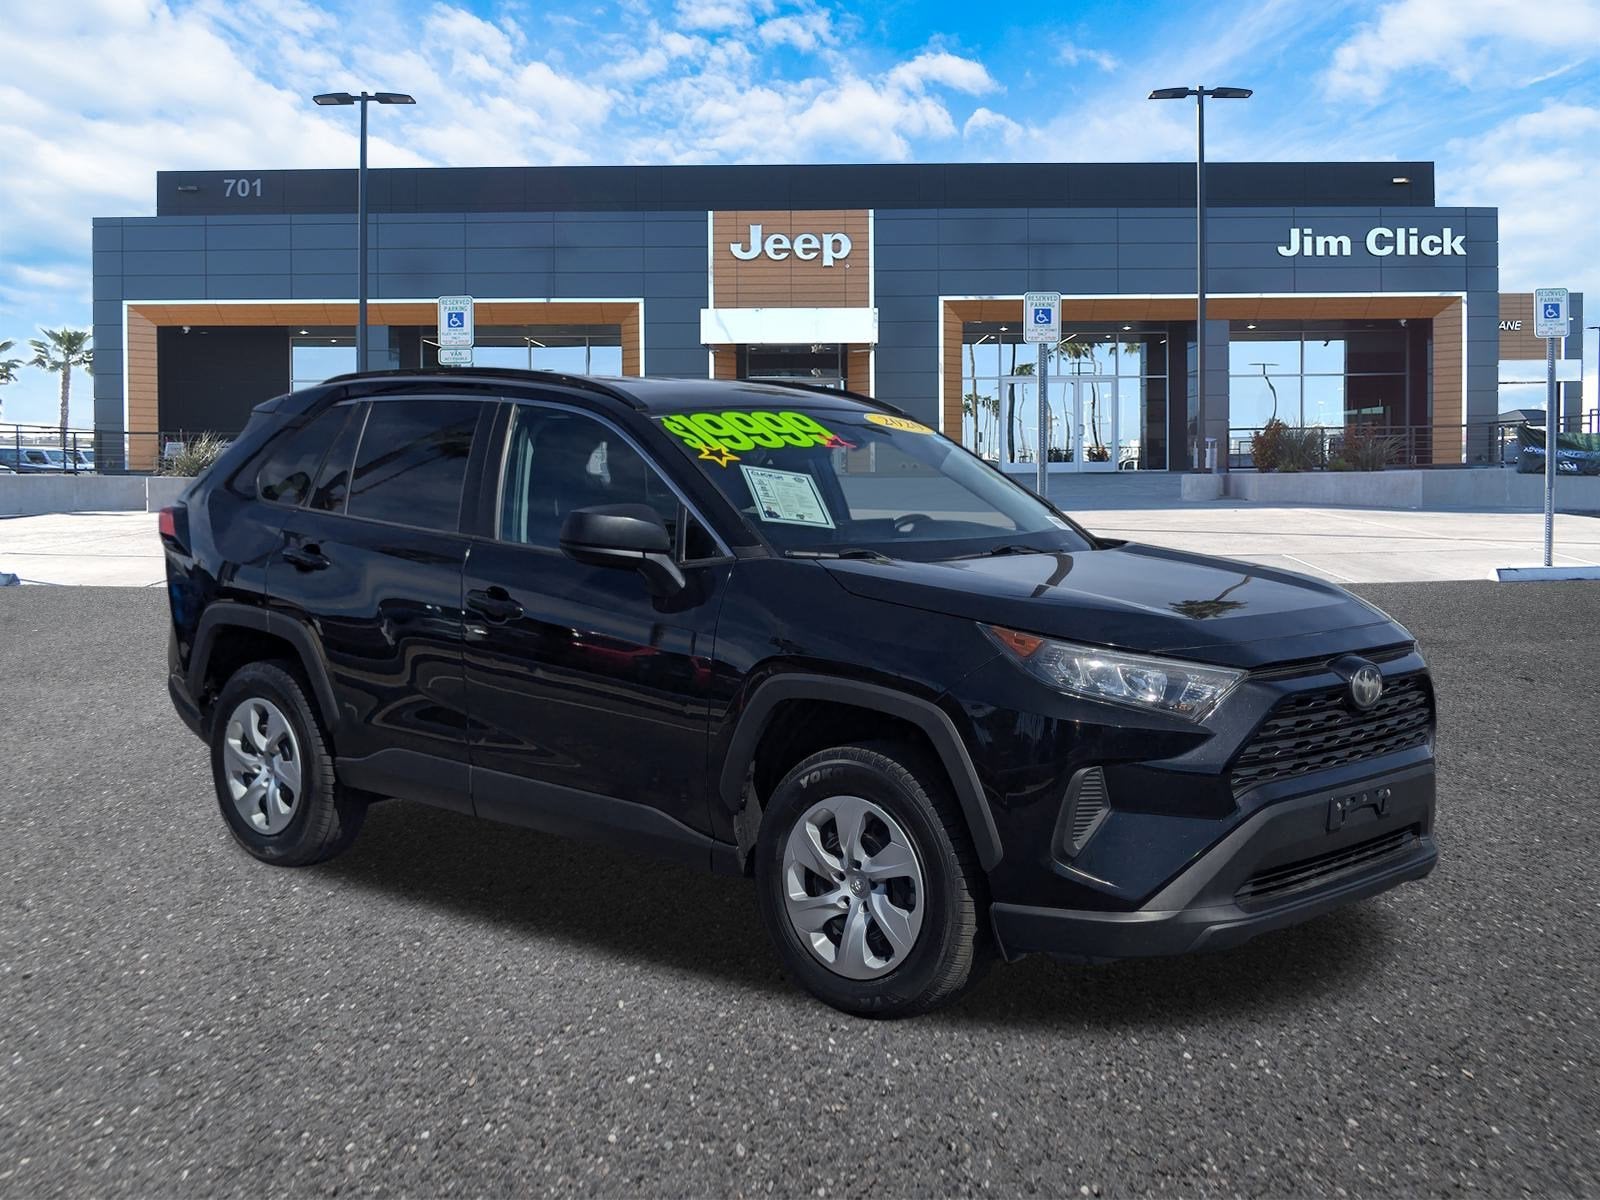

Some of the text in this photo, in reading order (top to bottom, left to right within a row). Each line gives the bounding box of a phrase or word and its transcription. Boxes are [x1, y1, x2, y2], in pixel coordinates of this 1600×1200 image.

[224, 178, 262, 197] 701
[730, 224, 852, 267] Jeep
[1277, 227, 1467, 257] Jim Click
[661, 411, 834, 451] $19999
